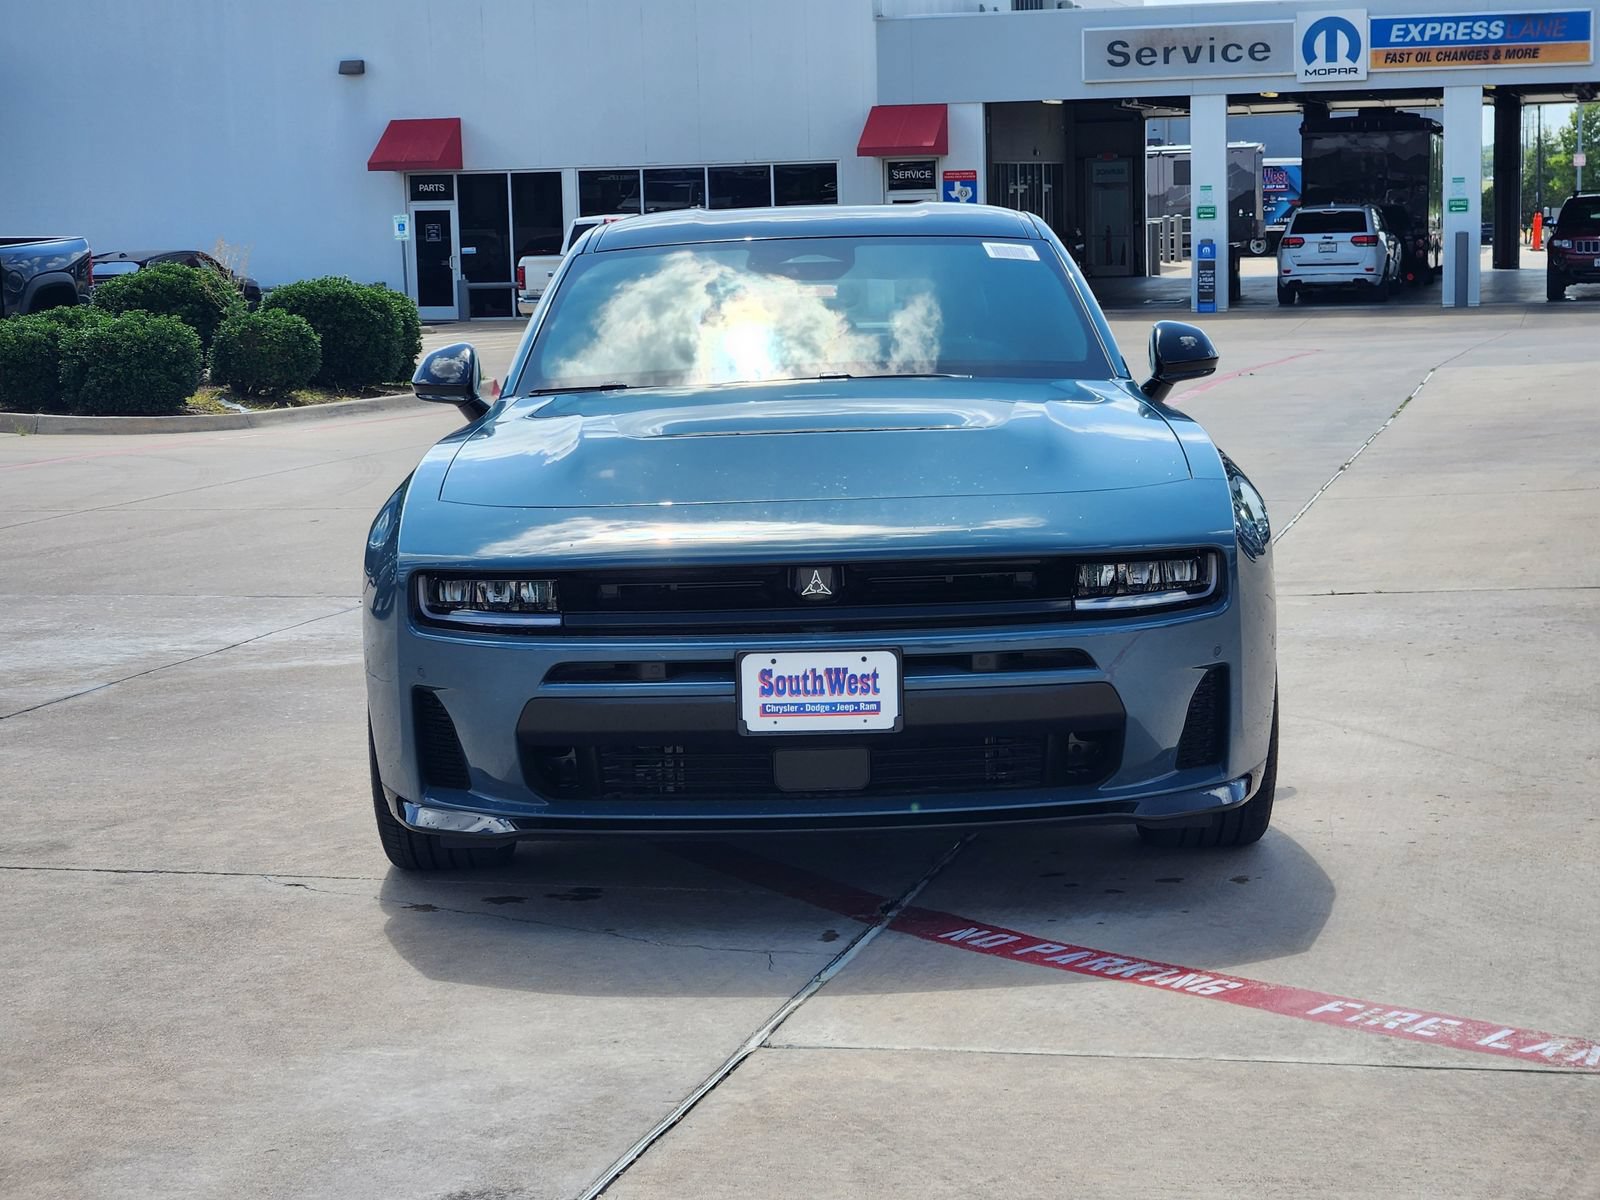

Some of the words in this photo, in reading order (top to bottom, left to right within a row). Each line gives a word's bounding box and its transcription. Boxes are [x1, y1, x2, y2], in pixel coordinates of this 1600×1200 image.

[1106, 36, 1271, 67] Service
[1384, 52, 1411, 64] FAST
[1415, 51, 1431, 63] OIL
[1435, 49, 1489, 62] CHANGES
[1492, 48, 1501, 60] &
[1504, 47, 1540, 60] MORE
[1304, 67, 1359, 76] MOPAR
[893, 170, 932, 179] SERVICE
[418, 184, 445, 192] PARTS
[758, 666, 881, 698] SouthWest
[765, 703, 798, 714] Chrysler
[805, 703, 830, 713] Dodge
[836, 702, 854, 712] Jeep
[860, 702, 877, 711] Ram
[937, 927, 1021, 949] NO
[1014, 943, 1245, 996] PARKING
